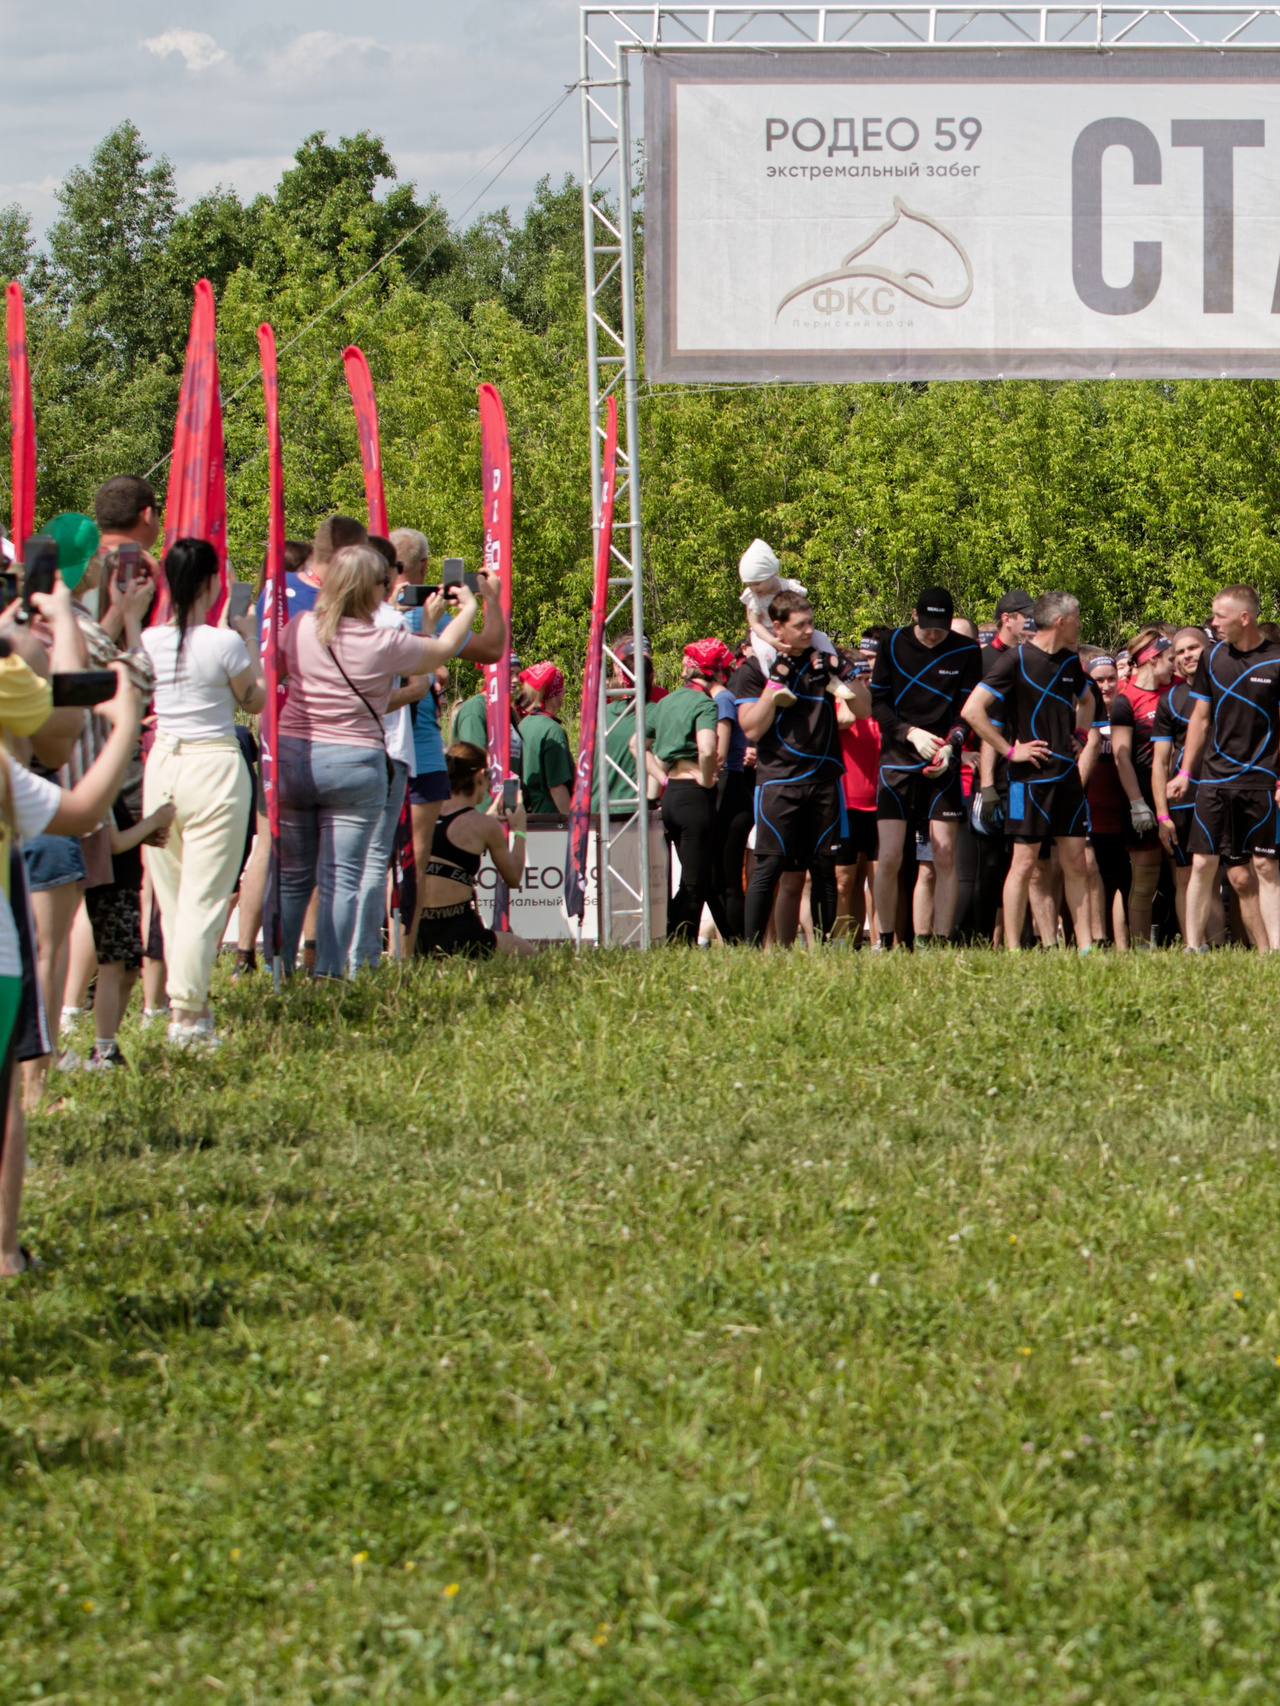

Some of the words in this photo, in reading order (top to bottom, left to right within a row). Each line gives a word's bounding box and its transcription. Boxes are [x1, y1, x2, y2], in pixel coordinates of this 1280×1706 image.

[766, 117, 920, 157] РОДЕО
[934, 117, 982, 151] 59
[766, 162, 920, 181] экстремальный
[926, 162, 981, 177] забег
[812, 287, 895, 316] ФКС
[793, 318, 870, 330] Пермский
[877, 318, 914, 330] край
